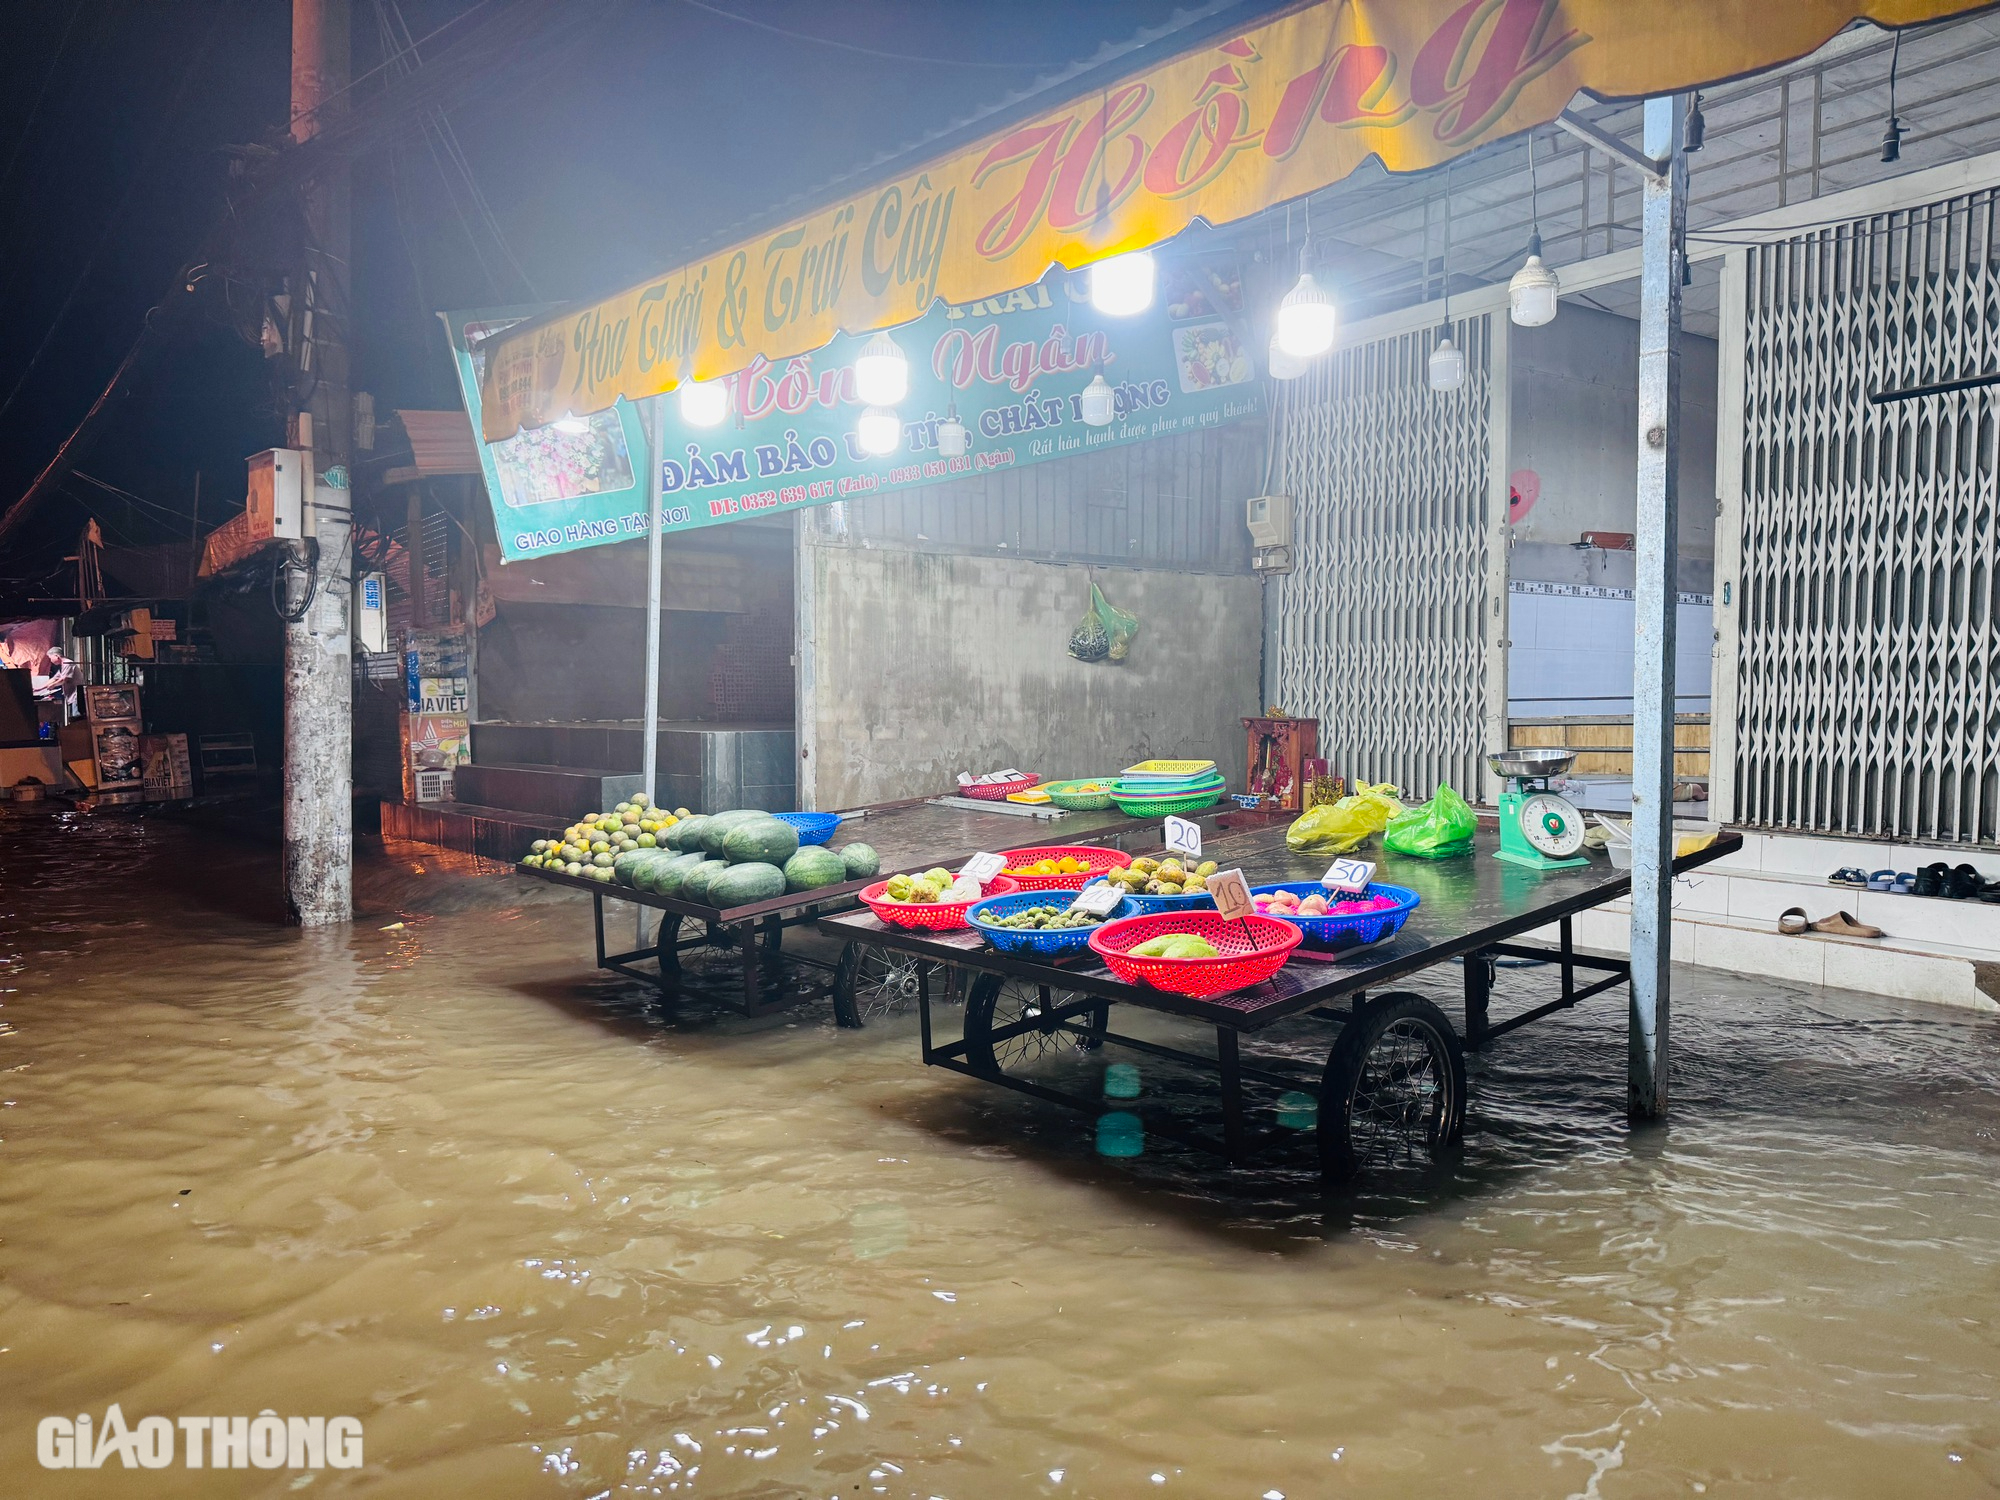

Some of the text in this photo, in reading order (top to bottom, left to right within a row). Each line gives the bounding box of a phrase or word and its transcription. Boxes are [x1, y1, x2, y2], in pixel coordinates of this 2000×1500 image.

[571, 306, 630, 395] Hoa
[637, 265, 708, 373] Tươi
[717, 251, 748, 349] &
[763, 204, 854, 332] Trái
[862, 173, 956, 311] Cây
[971, 0, 1593, 261] Hồng
[932, 323, 1117, 392] Ngân
[662, 443, 749, 493] ĐẢM
[755, 429, 837, 477] BẢO
[979, 389, 1064, 438] CHẤT
[1068, 379, 1171, 422] LỢNG
[1029, 438, 1053, 457] Rất
[1058, 434, 1080, 451] hân
[1086, 426, 1115, 447] hạnh
[1120, 422, 1146, 439] được
[1152, 416, 1178, 436] phục
[1182, 415, 1195, 428] vụ
[740, 489, 777, 511] 0352
[779, 484, 806, 504] 639
[808, 479, 834, 500] 617
[838, 472, 879, 497] (Zalo)
[889, 464, 921, 485] 0933
[923, 460, 947, 478] 050
[948, 455, 971, 473] 031
[974, 446, 1015, 472] (Ngân)
[515, 529, 562, 551] GIAO
[566, 519, 617, 542] HÀNG
[661, 506, 690, 526] NƠI
[1171, 820, 1199, 850] 20
[964, 855, 1000, 875] 15
[1325, 859, 1368, 883] 30
[1215, 881, 1247, 916] 10
